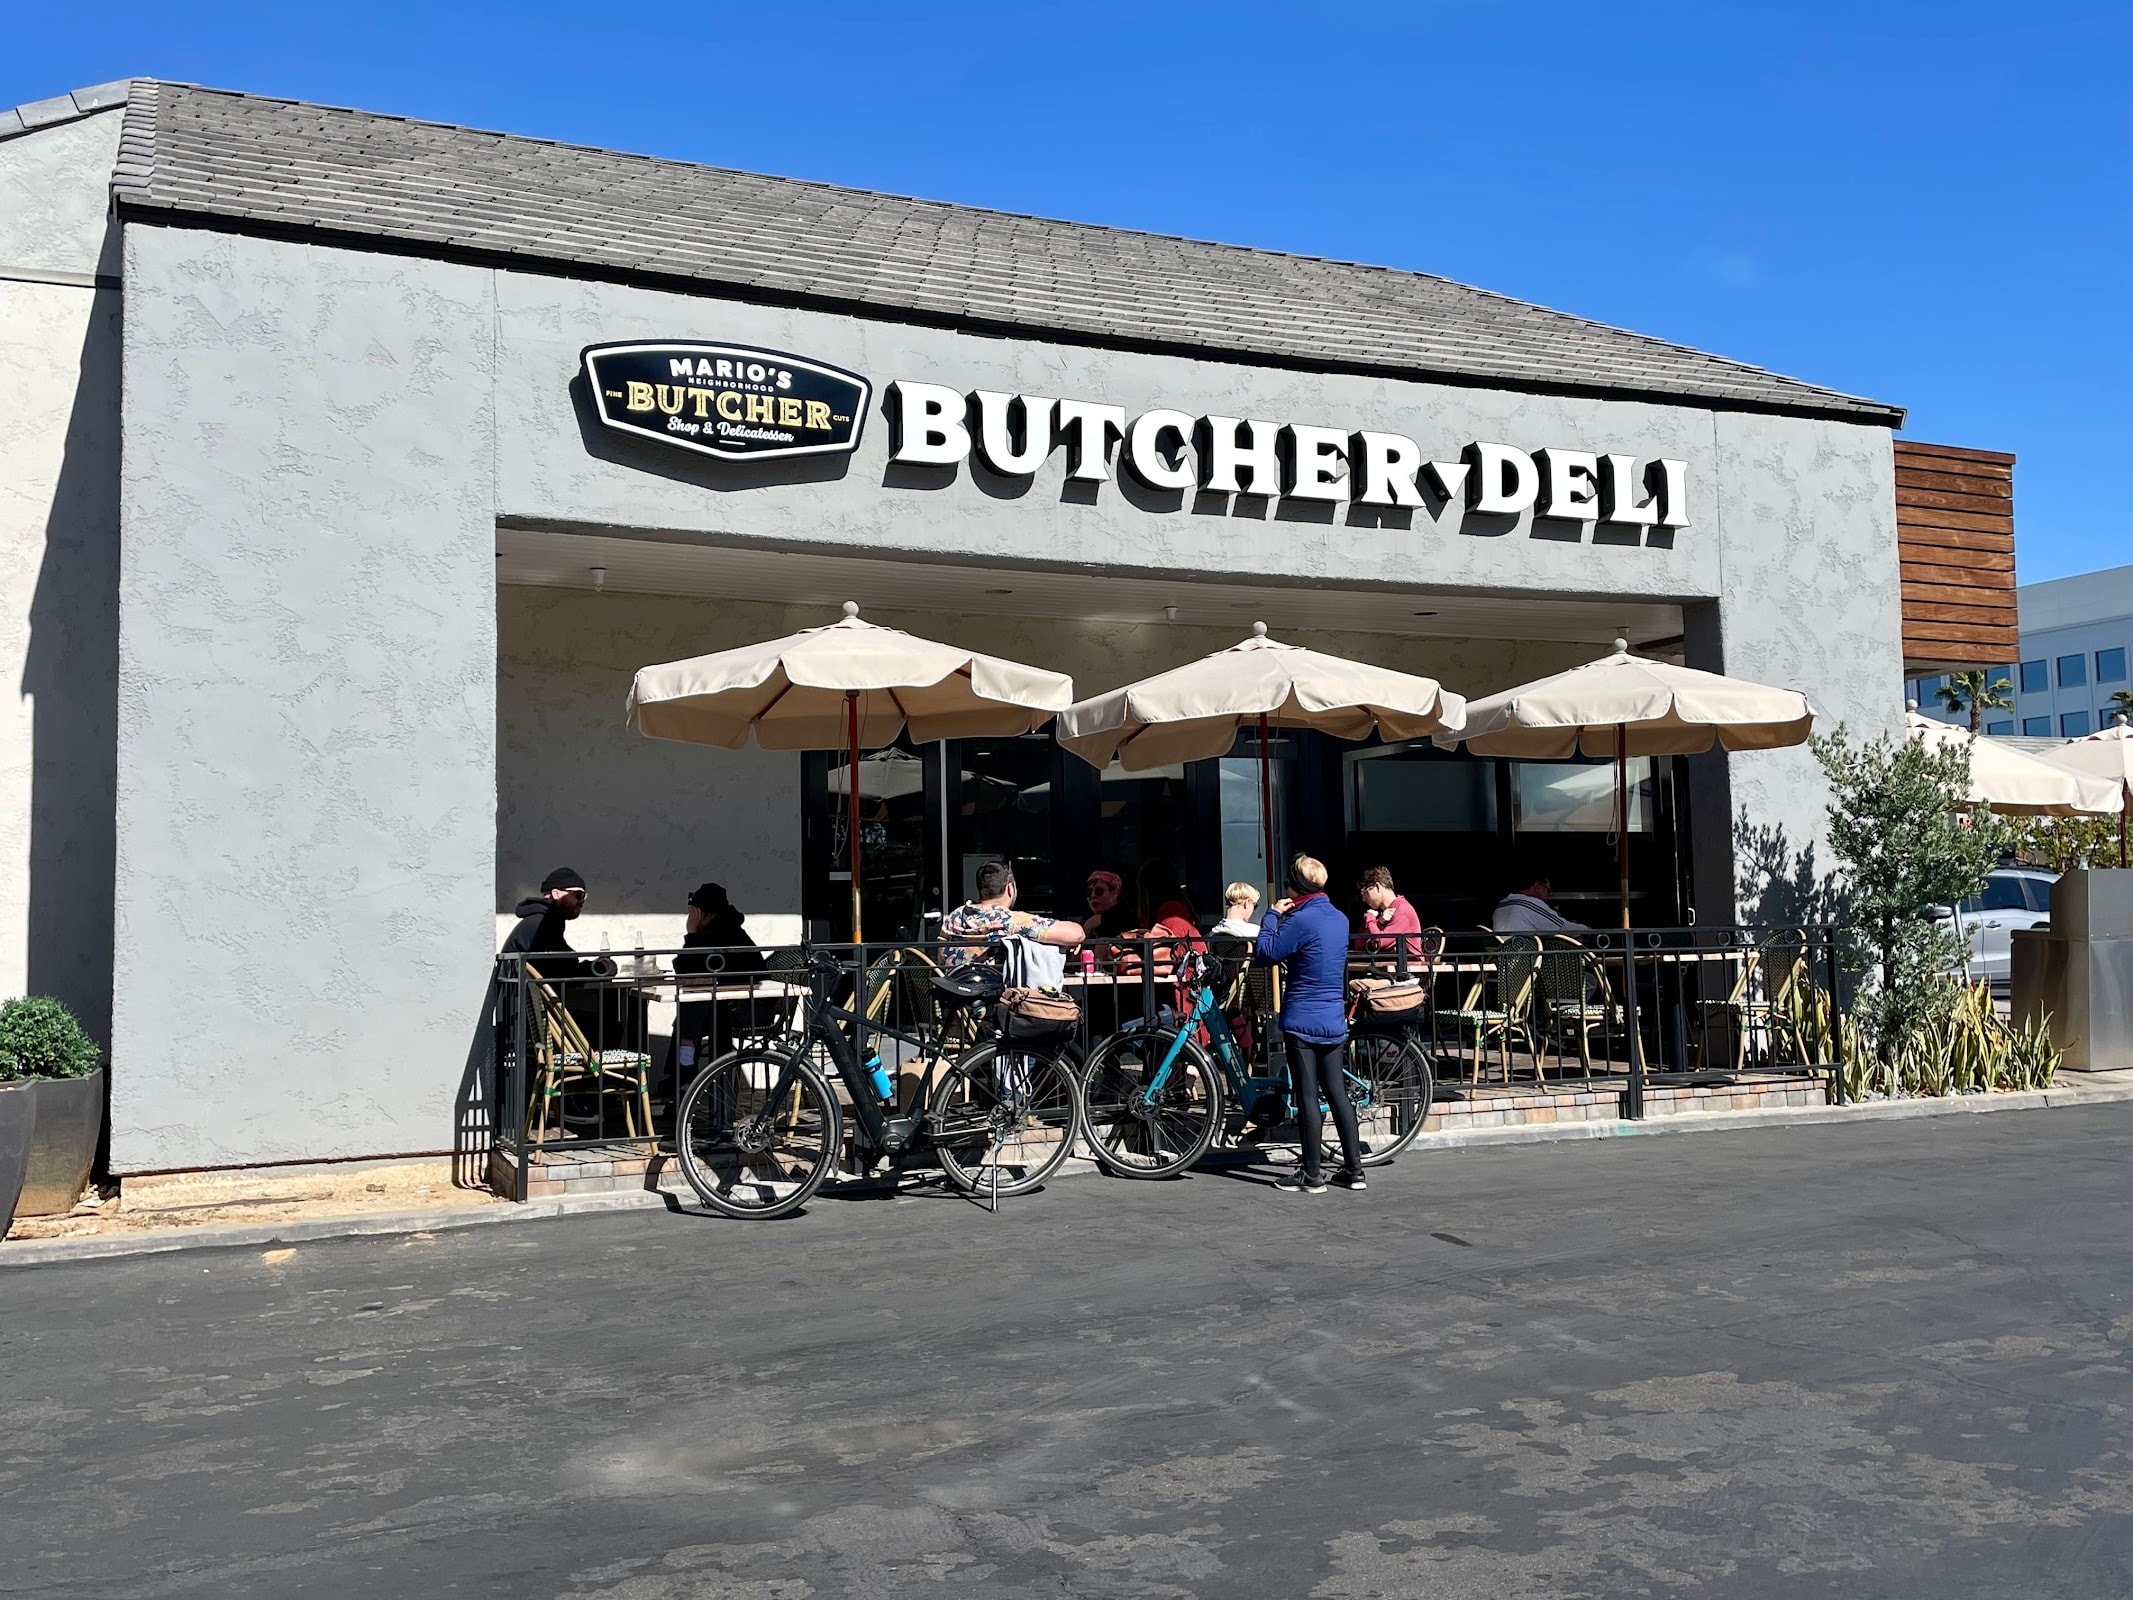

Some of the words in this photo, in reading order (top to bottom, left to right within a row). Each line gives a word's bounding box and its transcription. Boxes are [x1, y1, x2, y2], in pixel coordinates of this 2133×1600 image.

[669, 357, 793, 390] MARIO'S
[687, 376, 775, 393] NEIGHBORHOOD
[626, 380, 833, 430] BUTCHER
[832, 414, 850, 423] CUTS
[666, 415, 700, 436] Shop
[702, 421, 715, 435] &
[716, 421, 795, 443] Delicatessen
[893, 379, 1429, 508] BUTCHER
[1470, 440, 1692, 528] DELI
